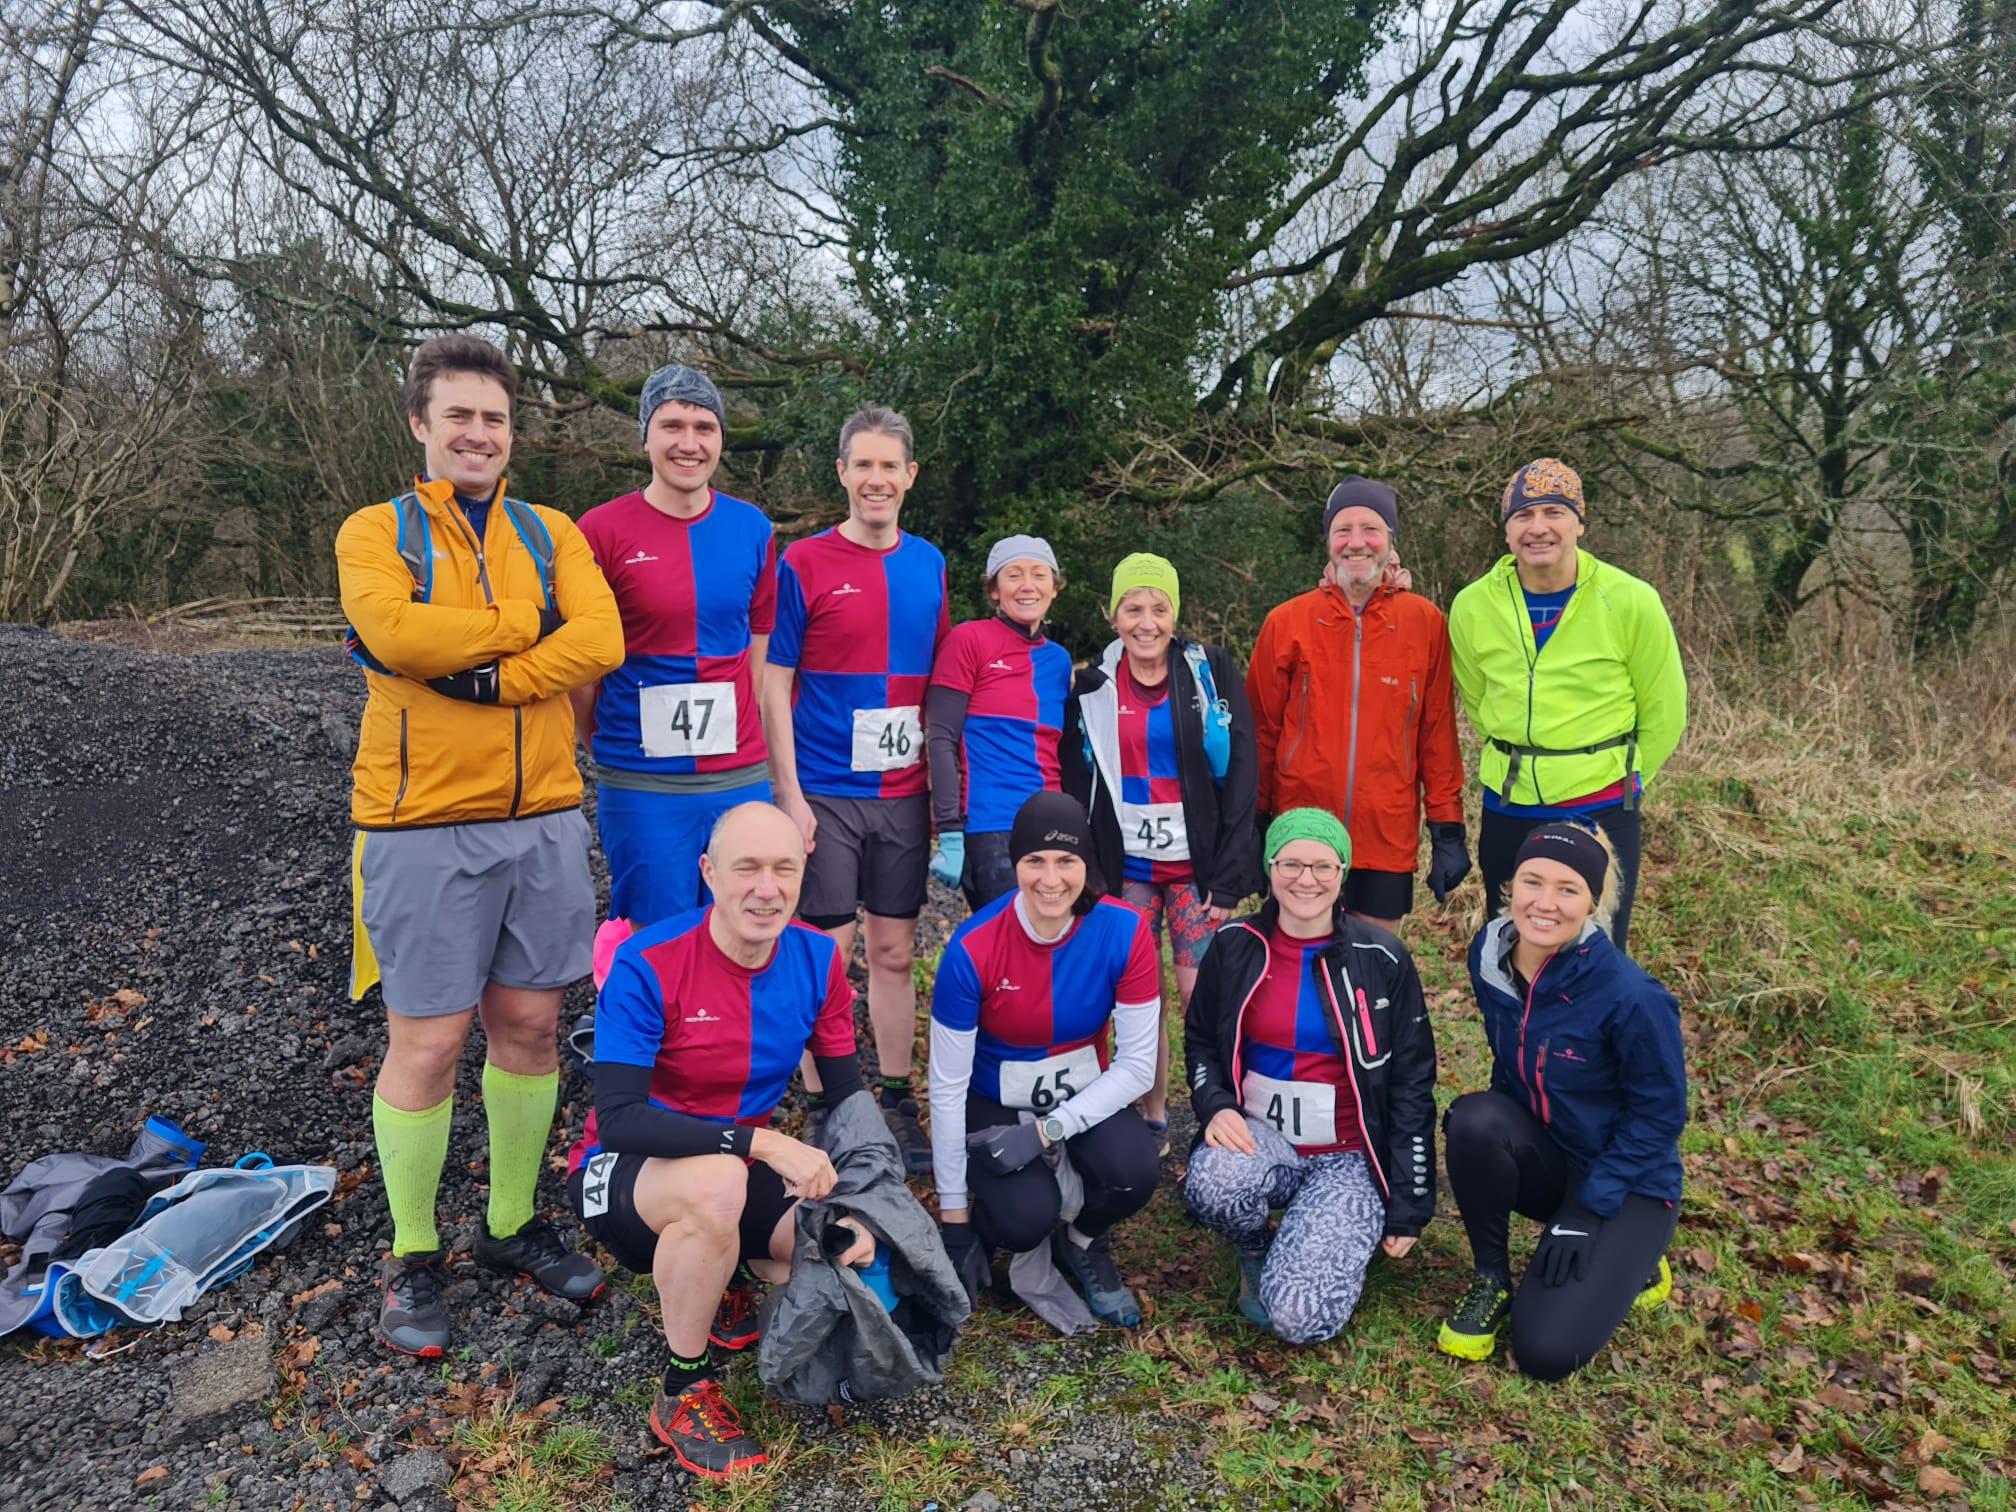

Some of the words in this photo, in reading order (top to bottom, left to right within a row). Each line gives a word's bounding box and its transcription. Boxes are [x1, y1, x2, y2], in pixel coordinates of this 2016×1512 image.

[671, 698, 714, 740] 47
[879, 721, 910, 757] 46
[1137, 816, 1174, 849] 45
[1031, 1067, 1076, 1107] 65
[1266, 1093, 1302, 1136] 41
[584, 1153, 615, 1206] 44
